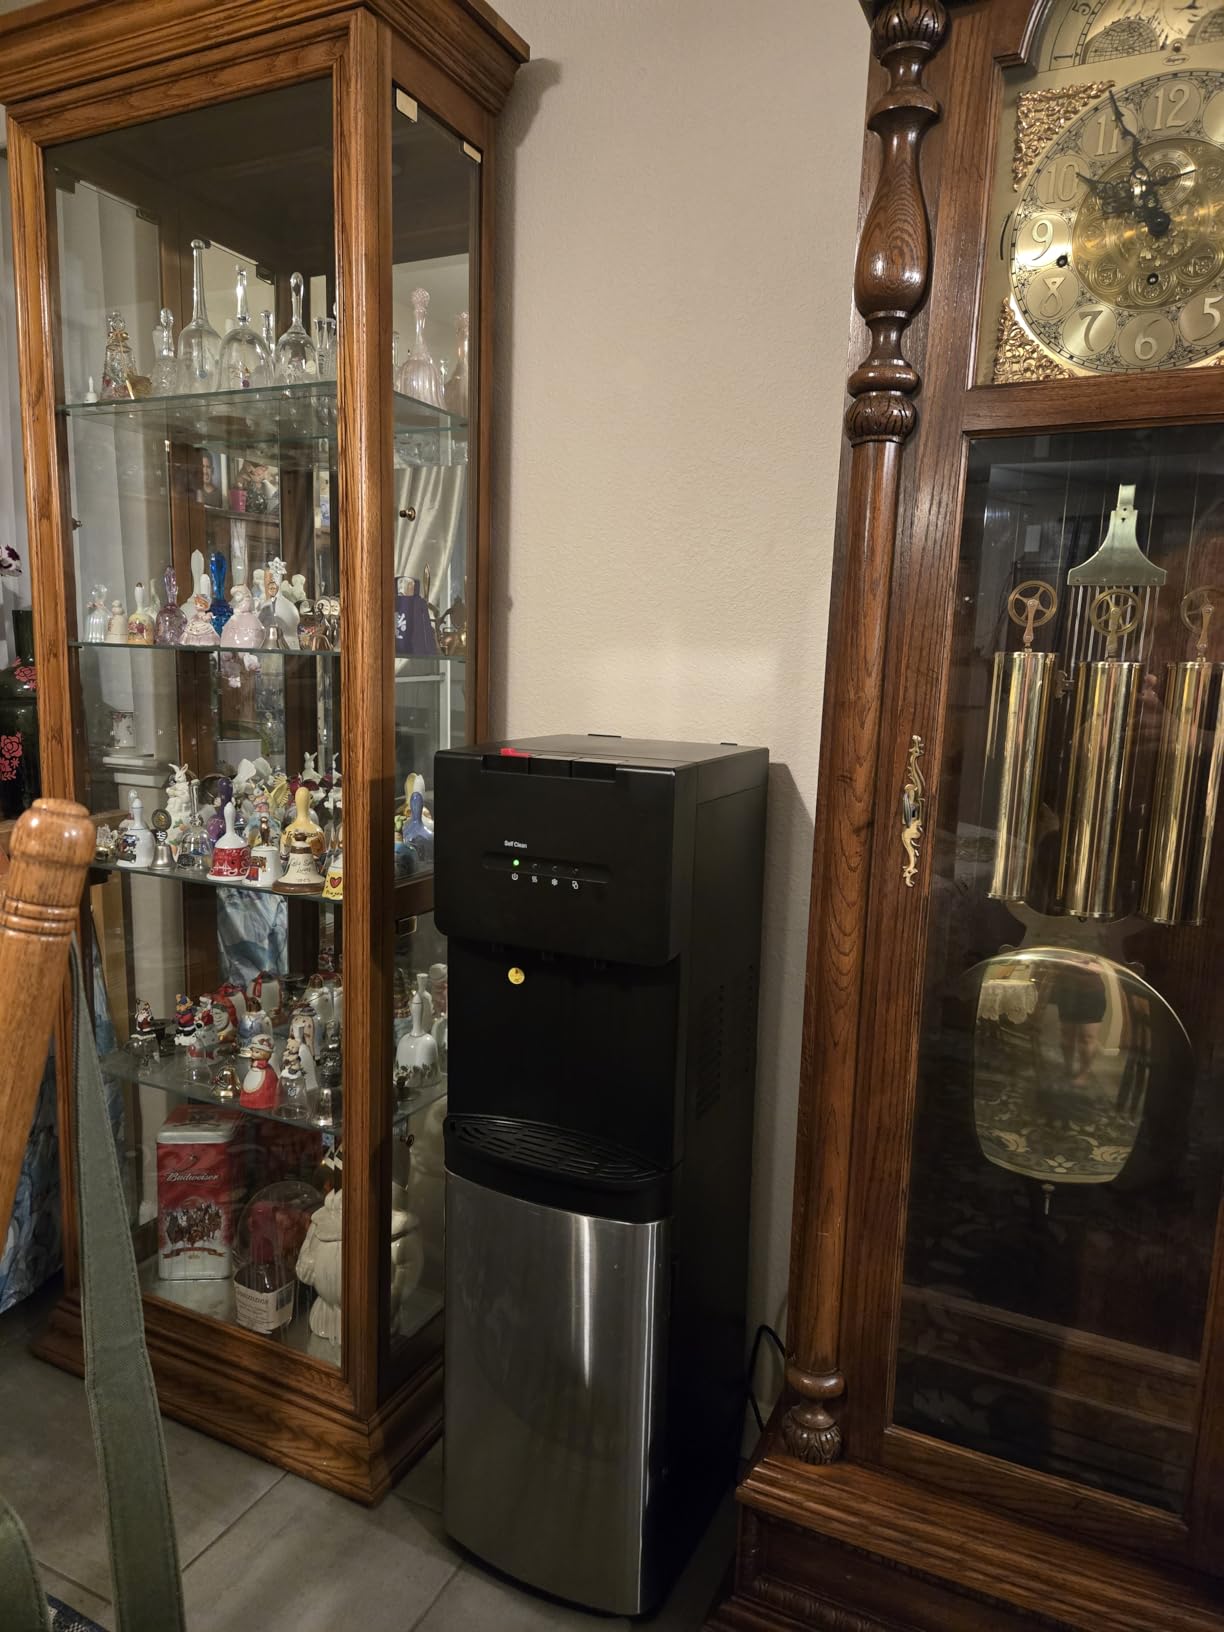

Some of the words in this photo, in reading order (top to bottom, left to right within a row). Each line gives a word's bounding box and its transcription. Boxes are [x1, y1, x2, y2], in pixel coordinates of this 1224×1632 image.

[1153, 88, 1190, 131] 12
[1095, 115, 1119, 157] 11
[1046, 163, 1079, 204] 10
[1030, 219, 1055, 261] 9
[1039, 276, 1065, 318] 8
[1079, 310, 1103, 352] 7
[1134, 318, 1161, 360] 6
[1192, 295, 1223, 342] 5
[166, 1172, 219, 1182] Budweiser
